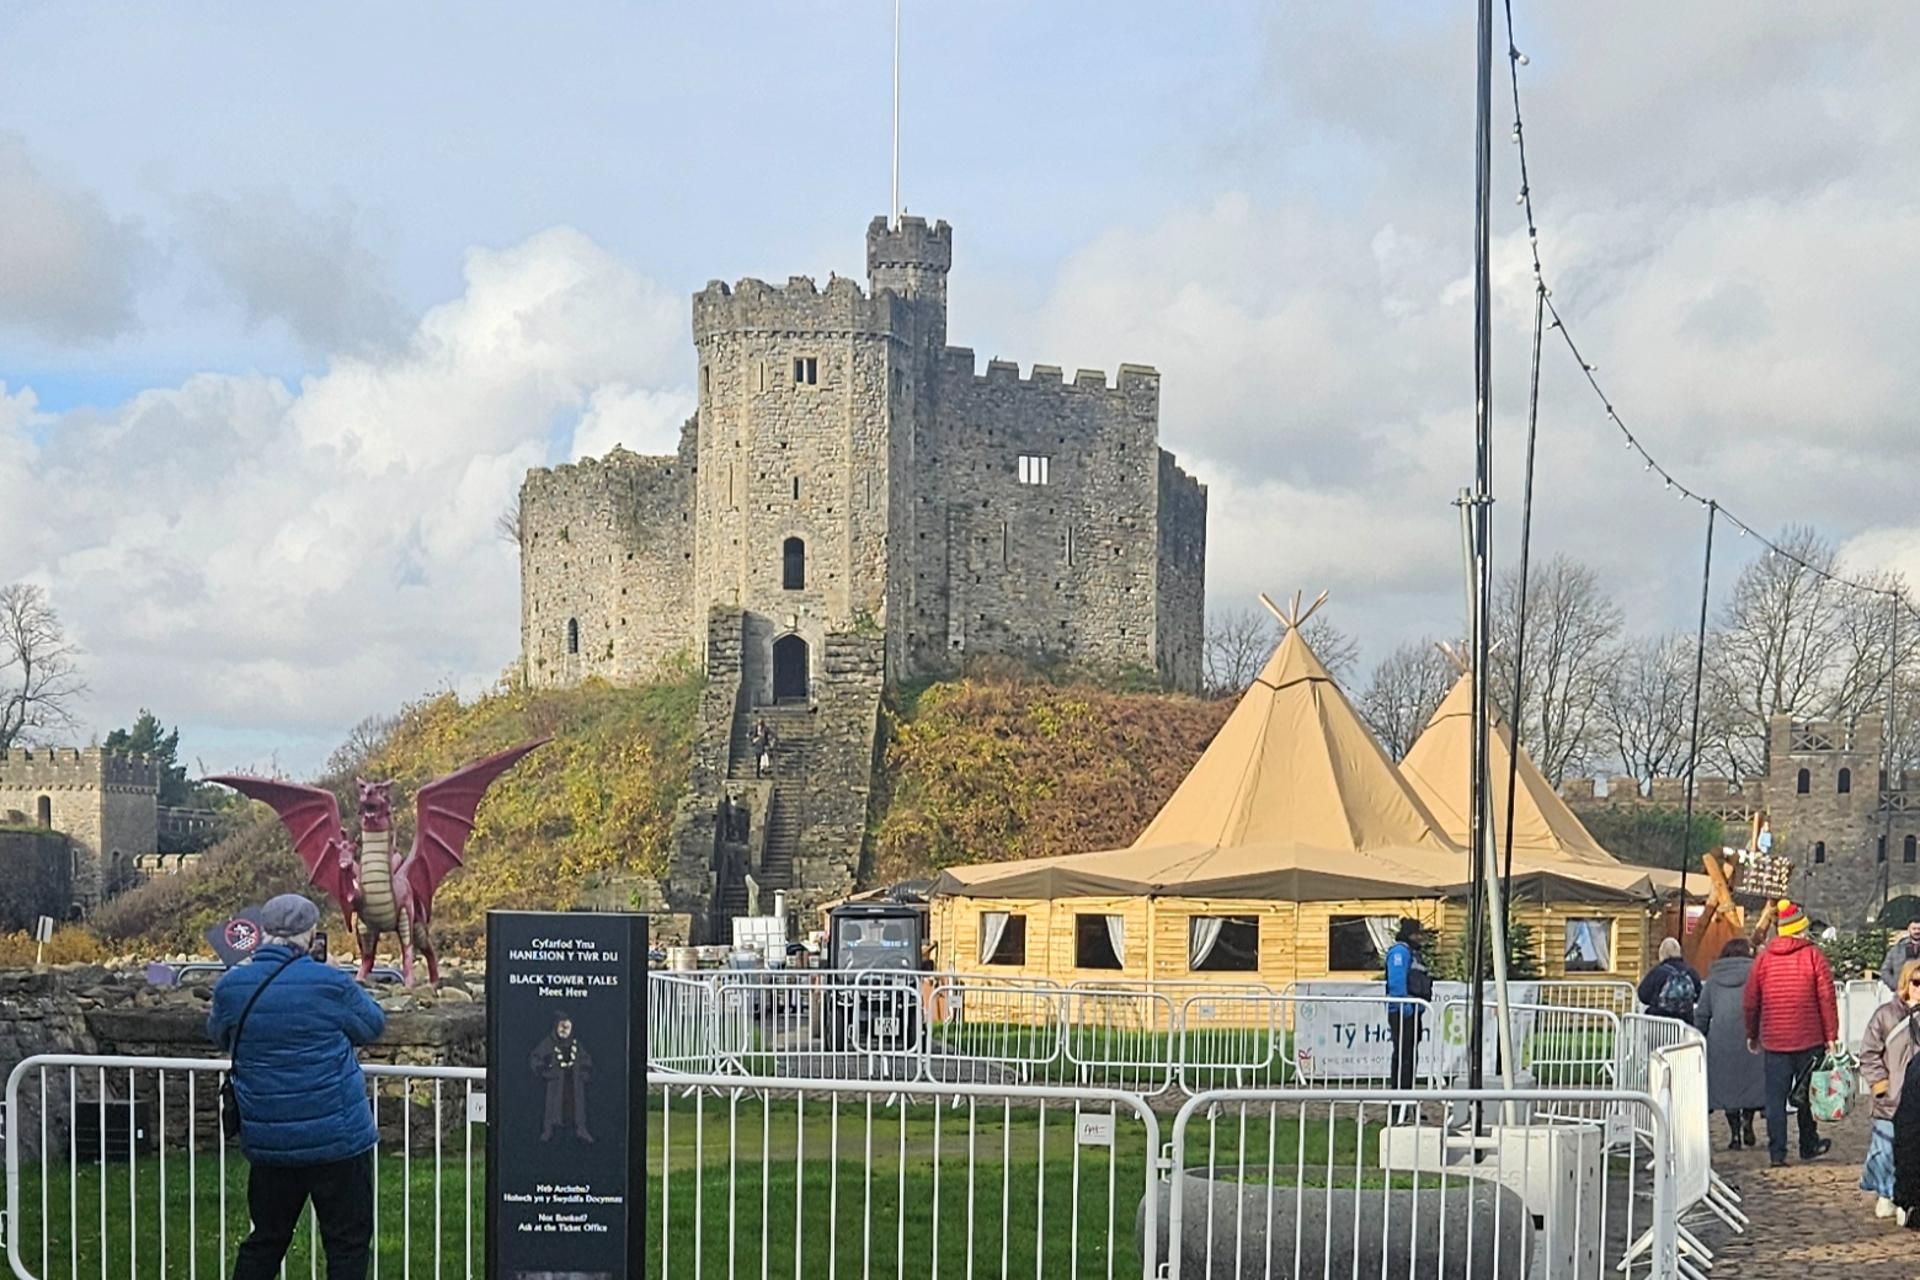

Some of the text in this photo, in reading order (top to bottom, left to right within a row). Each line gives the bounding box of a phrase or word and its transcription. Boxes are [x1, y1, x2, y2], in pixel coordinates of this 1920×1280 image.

[532, 938, 595, 949] Cyfarfod Yma
[509, 950, 565, 960] HANESION
[567, 952, 575, 960] Y
[602, 952, 618, 961] DU
[509, 974, 618, 985] BLACK TOWER TALES
[539, 986, 588, 997] Meet Here
[518, 1223, 532, 1231] Ask
[544, 1223, 556, 1231] the
[558, 1223, 581, 1232] Ticket
[583, 1223, 608, 1232] Office
